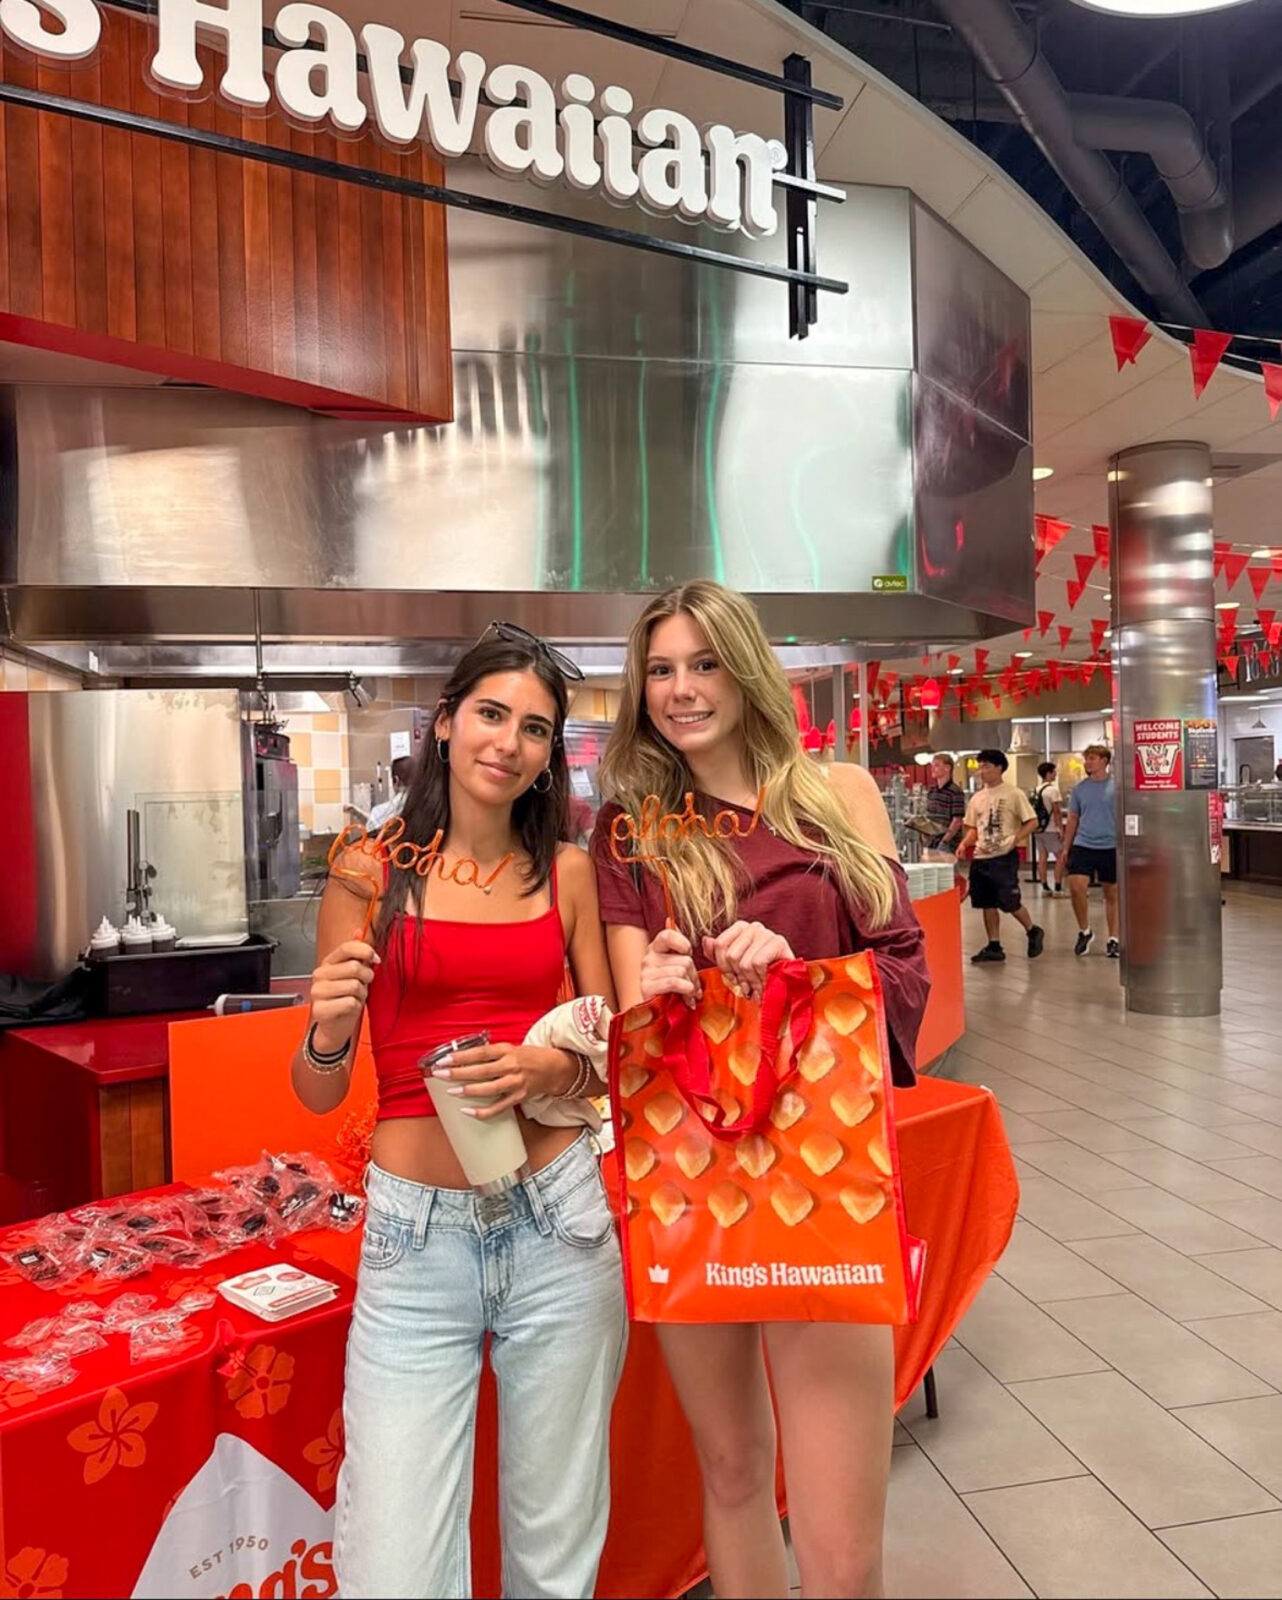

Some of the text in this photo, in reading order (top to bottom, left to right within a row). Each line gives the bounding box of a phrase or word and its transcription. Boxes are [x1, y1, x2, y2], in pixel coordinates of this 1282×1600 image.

[1135, 721, 1180, 732] WELCOME
[1136, 731, 1179, 740] STUDENTS
[706, 1262, 884, 1288] King's Hawaiian
[189, 1535, 269, 1580] EST 1950
